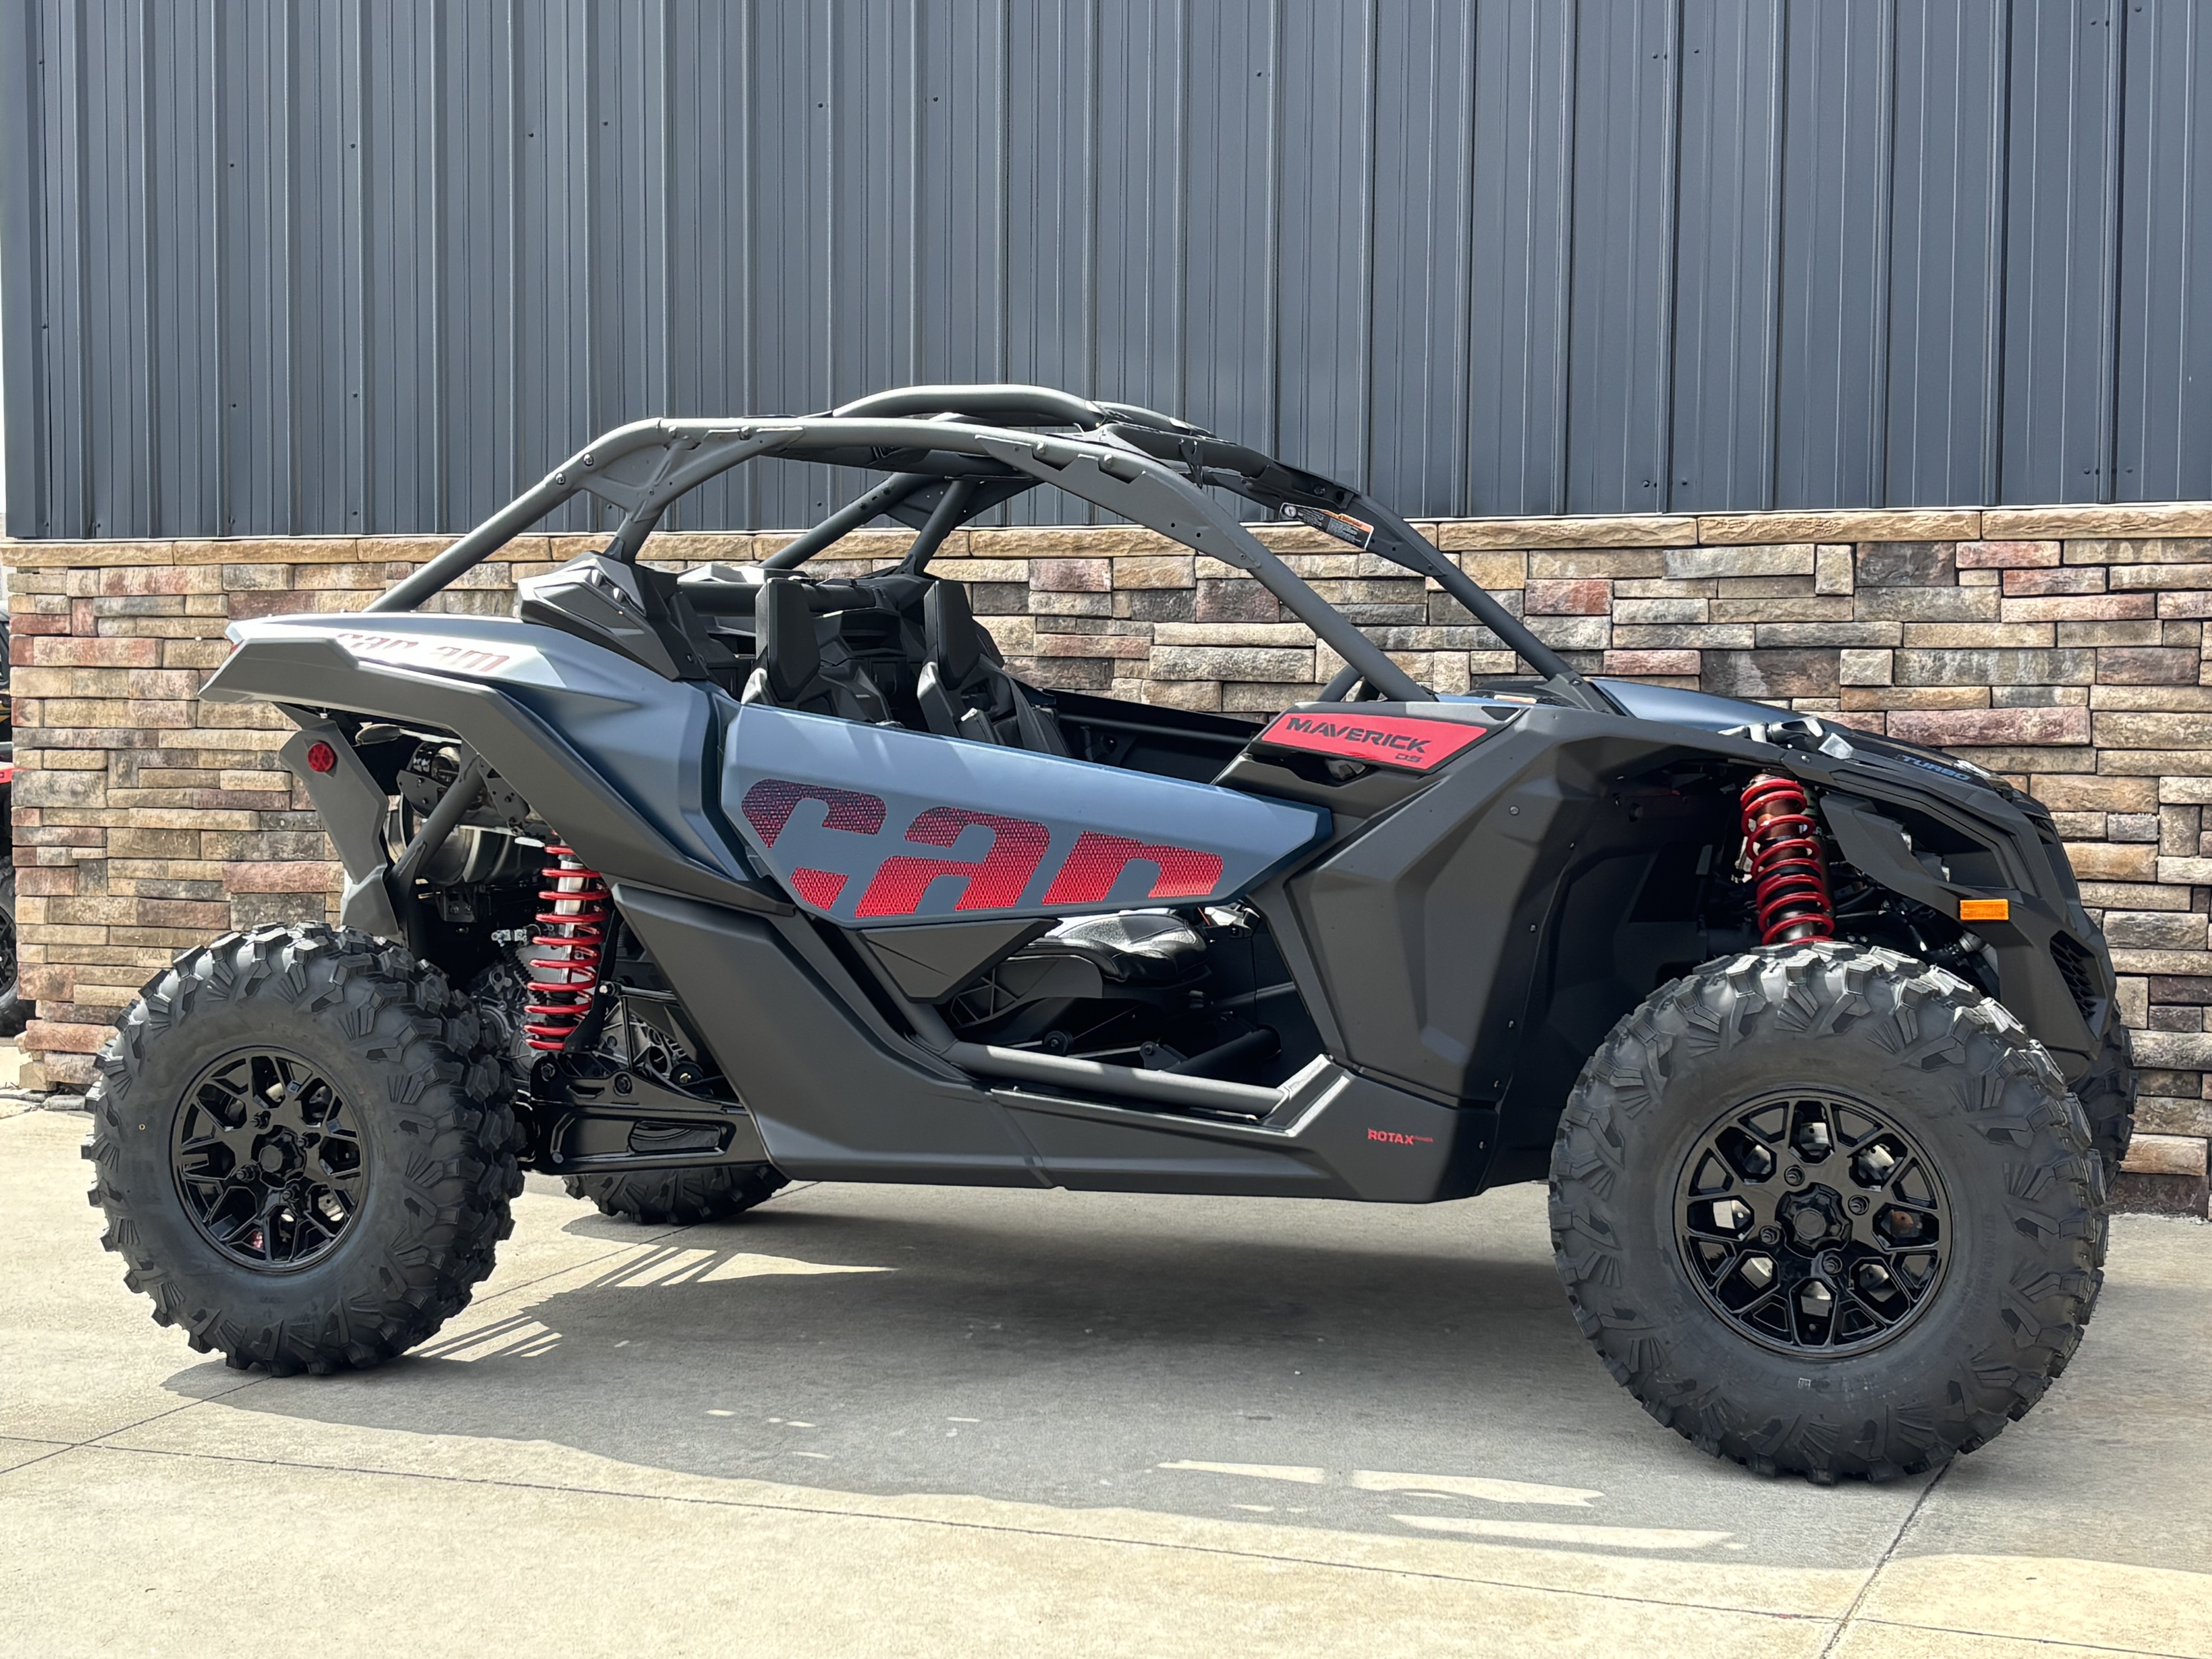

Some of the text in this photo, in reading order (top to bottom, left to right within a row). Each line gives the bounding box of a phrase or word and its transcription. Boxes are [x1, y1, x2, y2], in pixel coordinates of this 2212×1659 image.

[1286, 717, 1432, 754] MAVERICK
[1395, 753, 1422, 763] DS
[1901, 755, 1971, 781] TURBO
[1368, 1128, 1414, 1145] ROTAX
